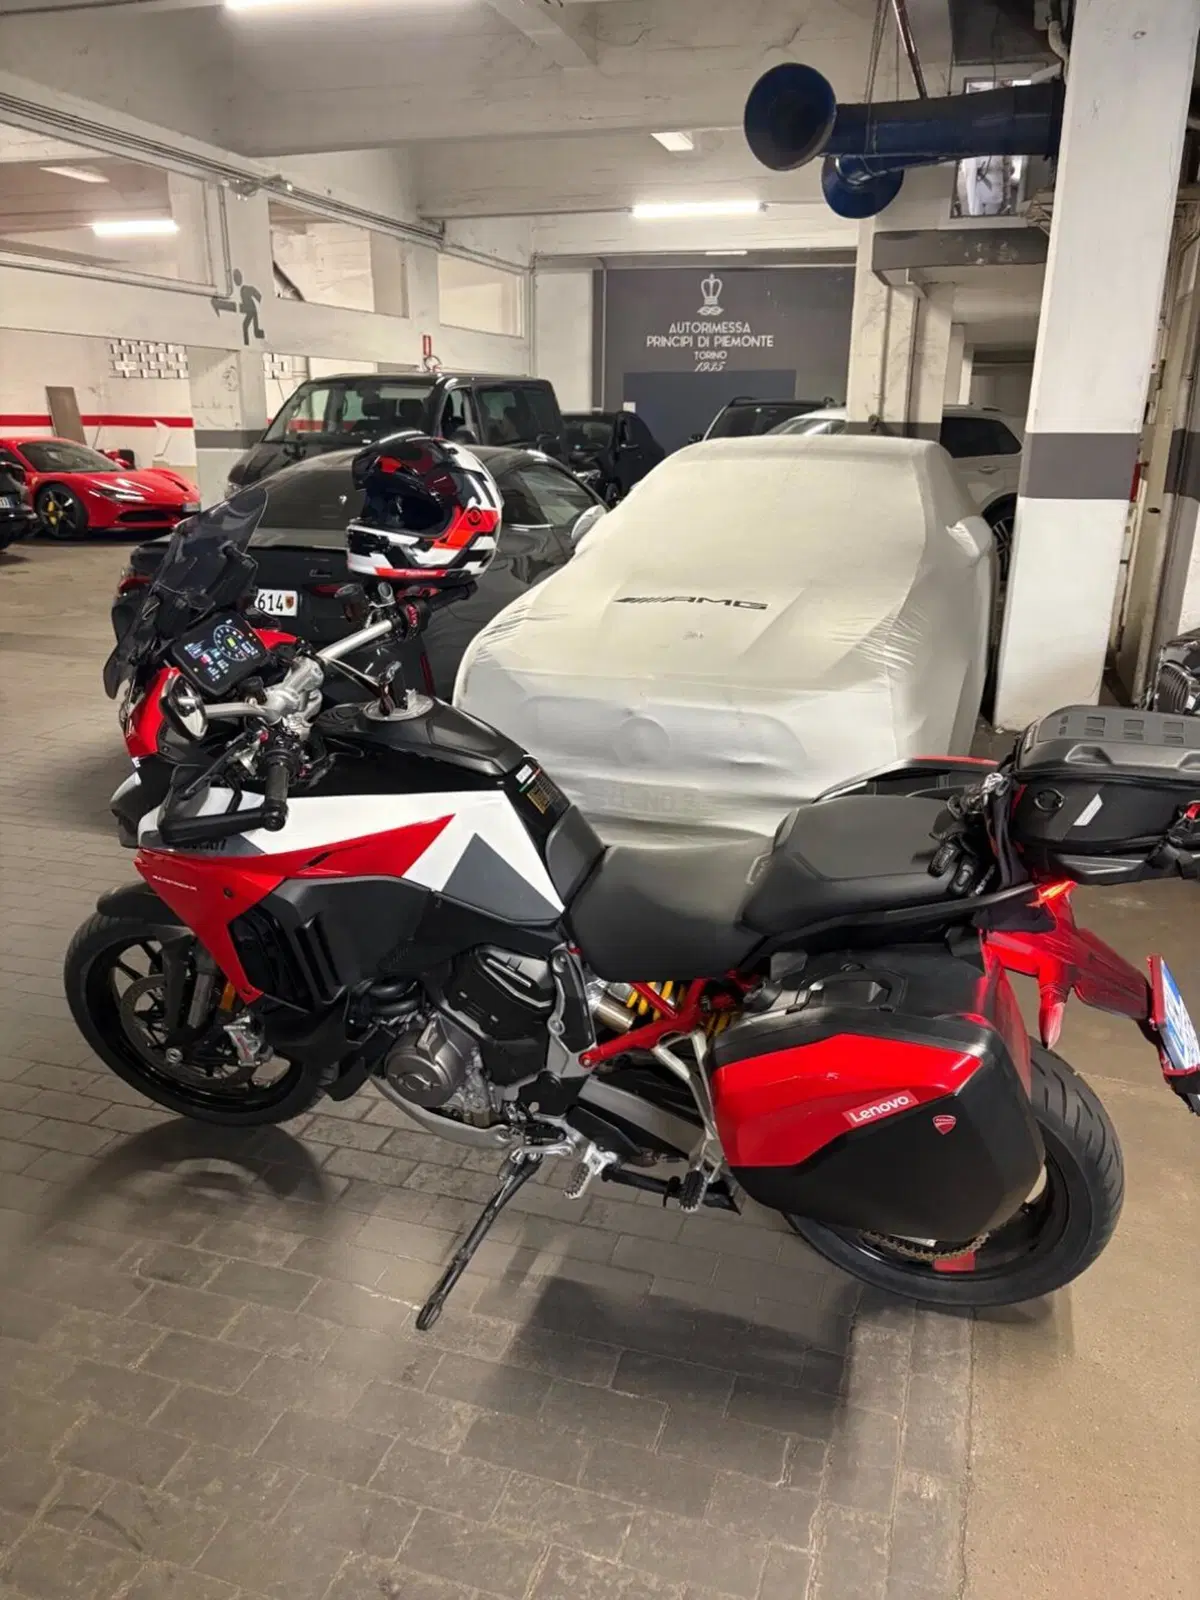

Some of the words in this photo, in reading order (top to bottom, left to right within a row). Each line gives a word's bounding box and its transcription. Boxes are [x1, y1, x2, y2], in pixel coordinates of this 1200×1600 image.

[669, 321, 751, 333] AUTORIMESSA
[646, 335, 693, 347] PRINCIPI
[698, 335, 710, 347] DI
[714, 335, 774, 347] PIEMONTE
[694, 350, 728, 360] TORINO
[257, 592, 284, 612] 614
[849, 1095, 910, 1124] Lenovo
